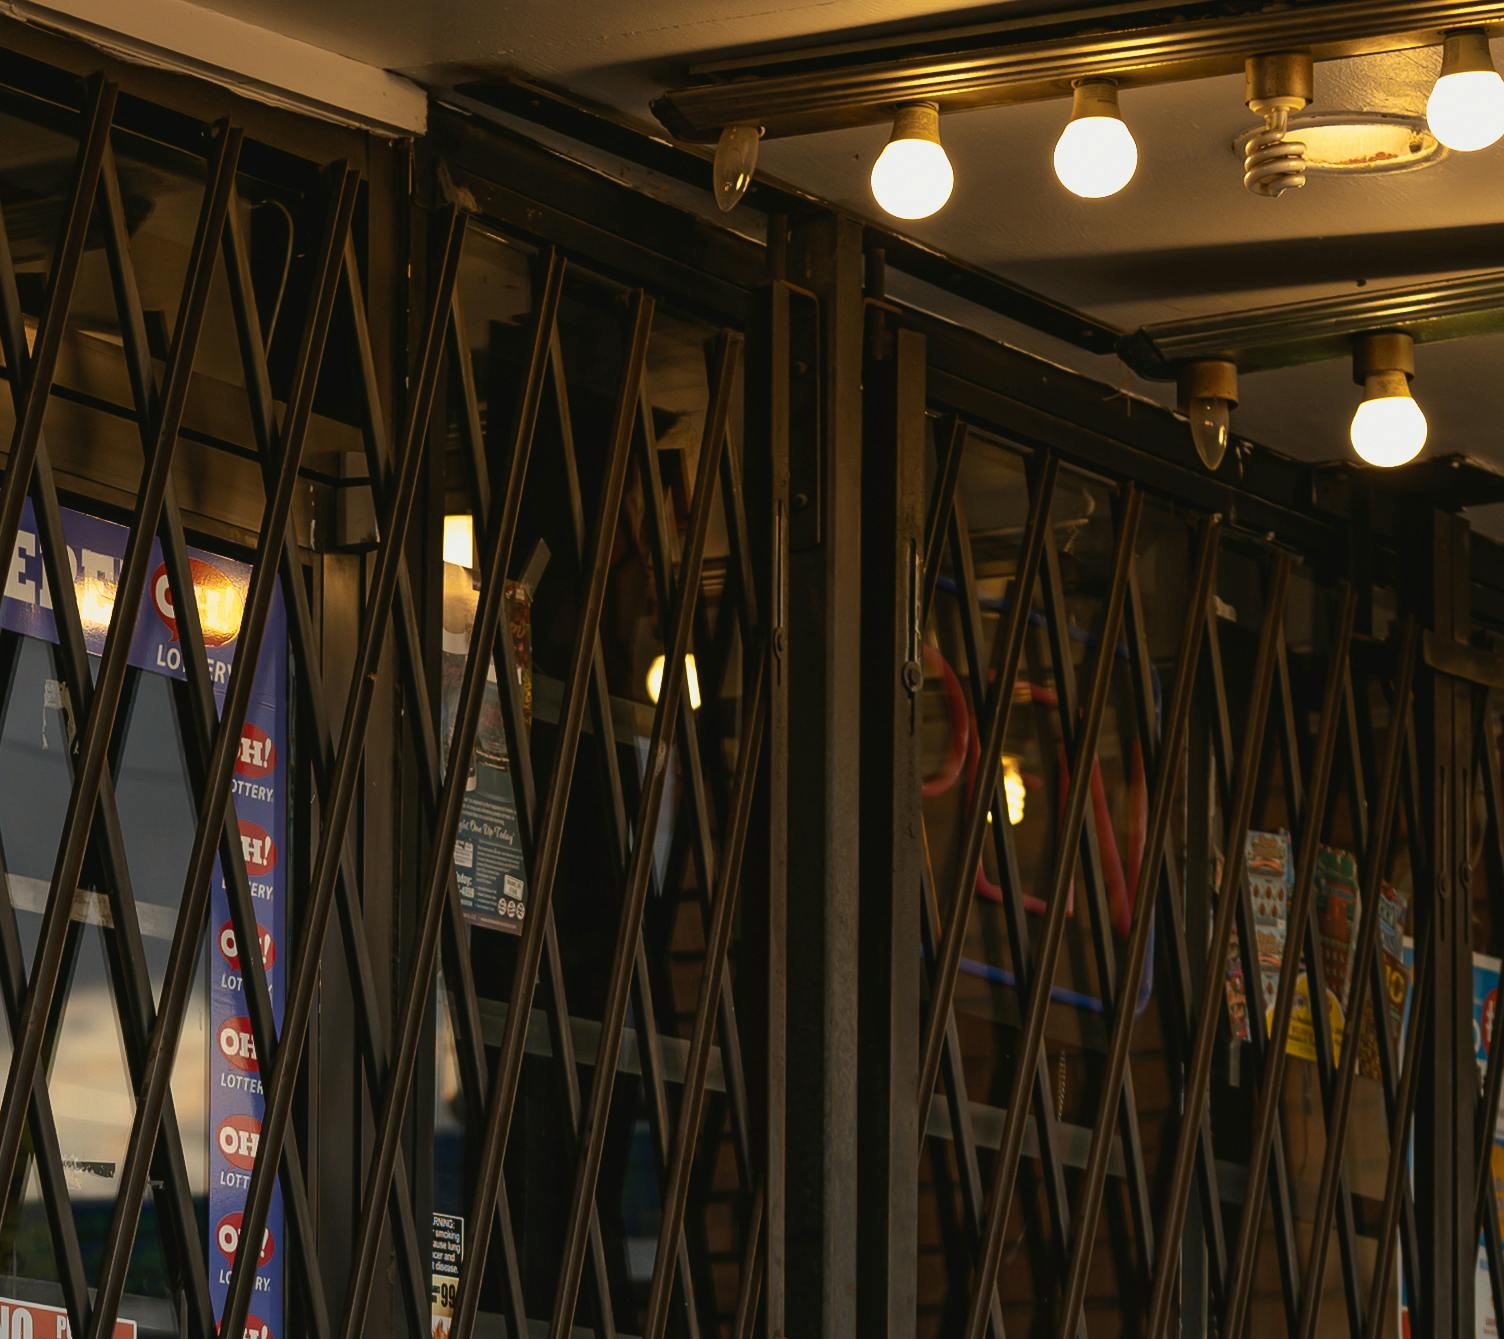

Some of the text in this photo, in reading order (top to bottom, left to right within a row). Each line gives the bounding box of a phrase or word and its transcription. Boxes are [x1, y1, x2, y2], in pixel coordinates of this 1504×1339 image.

[232, 780, 274, 802] OTTERY
[221, 1073, 264, 1095] LOTTER
[435, 1228, 461, 1243] smoking
